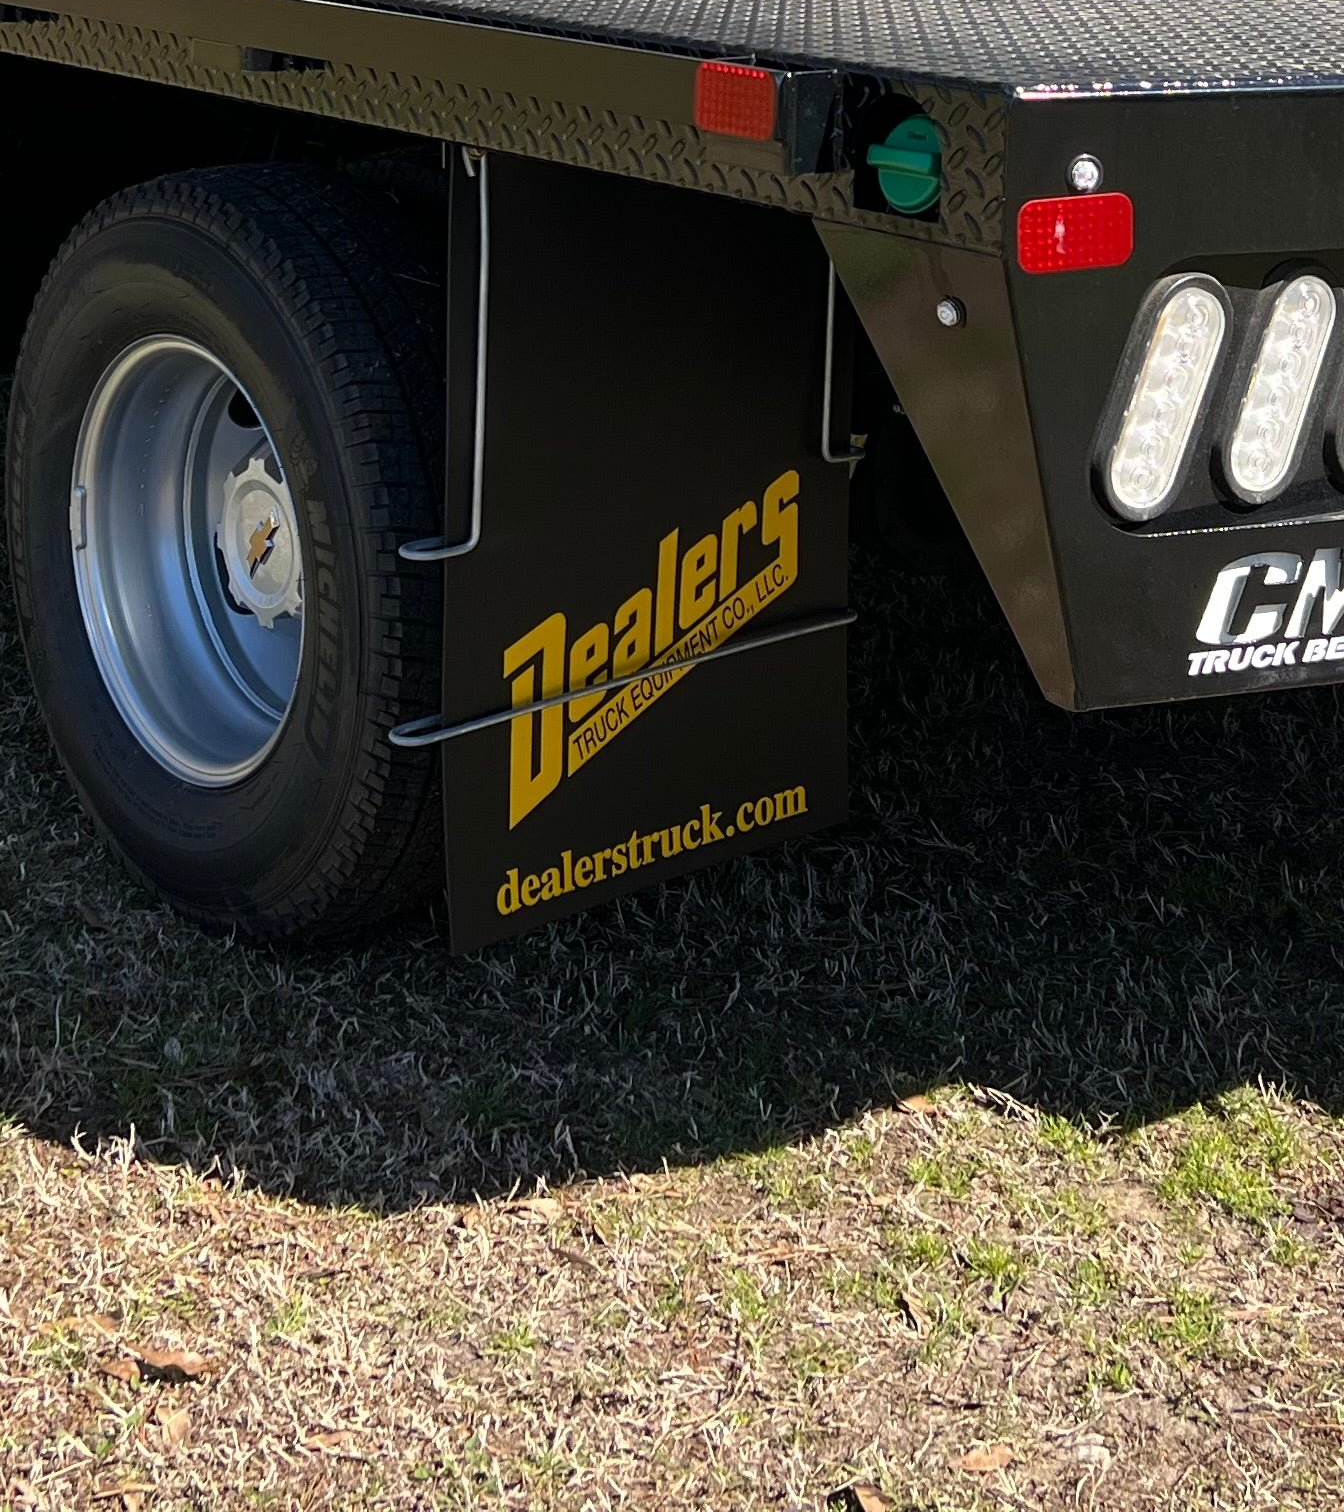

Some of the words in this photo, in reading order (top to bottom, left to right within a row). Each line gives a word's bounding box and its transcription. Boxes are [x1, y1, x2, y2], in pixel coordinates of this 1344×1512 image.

[307, 498, 341, 751] MICHELIN
[502, 469, 800, 831] Dealers
[572, 695, 631, 761] TRUCK
[630, 616, 720, 713] EQUIPMENT
[755, 563, 790, 604] LLC.
[1187, 639, 1301, 676] TRUCK
[495, 784, 809, 917] dealerstruck.com
